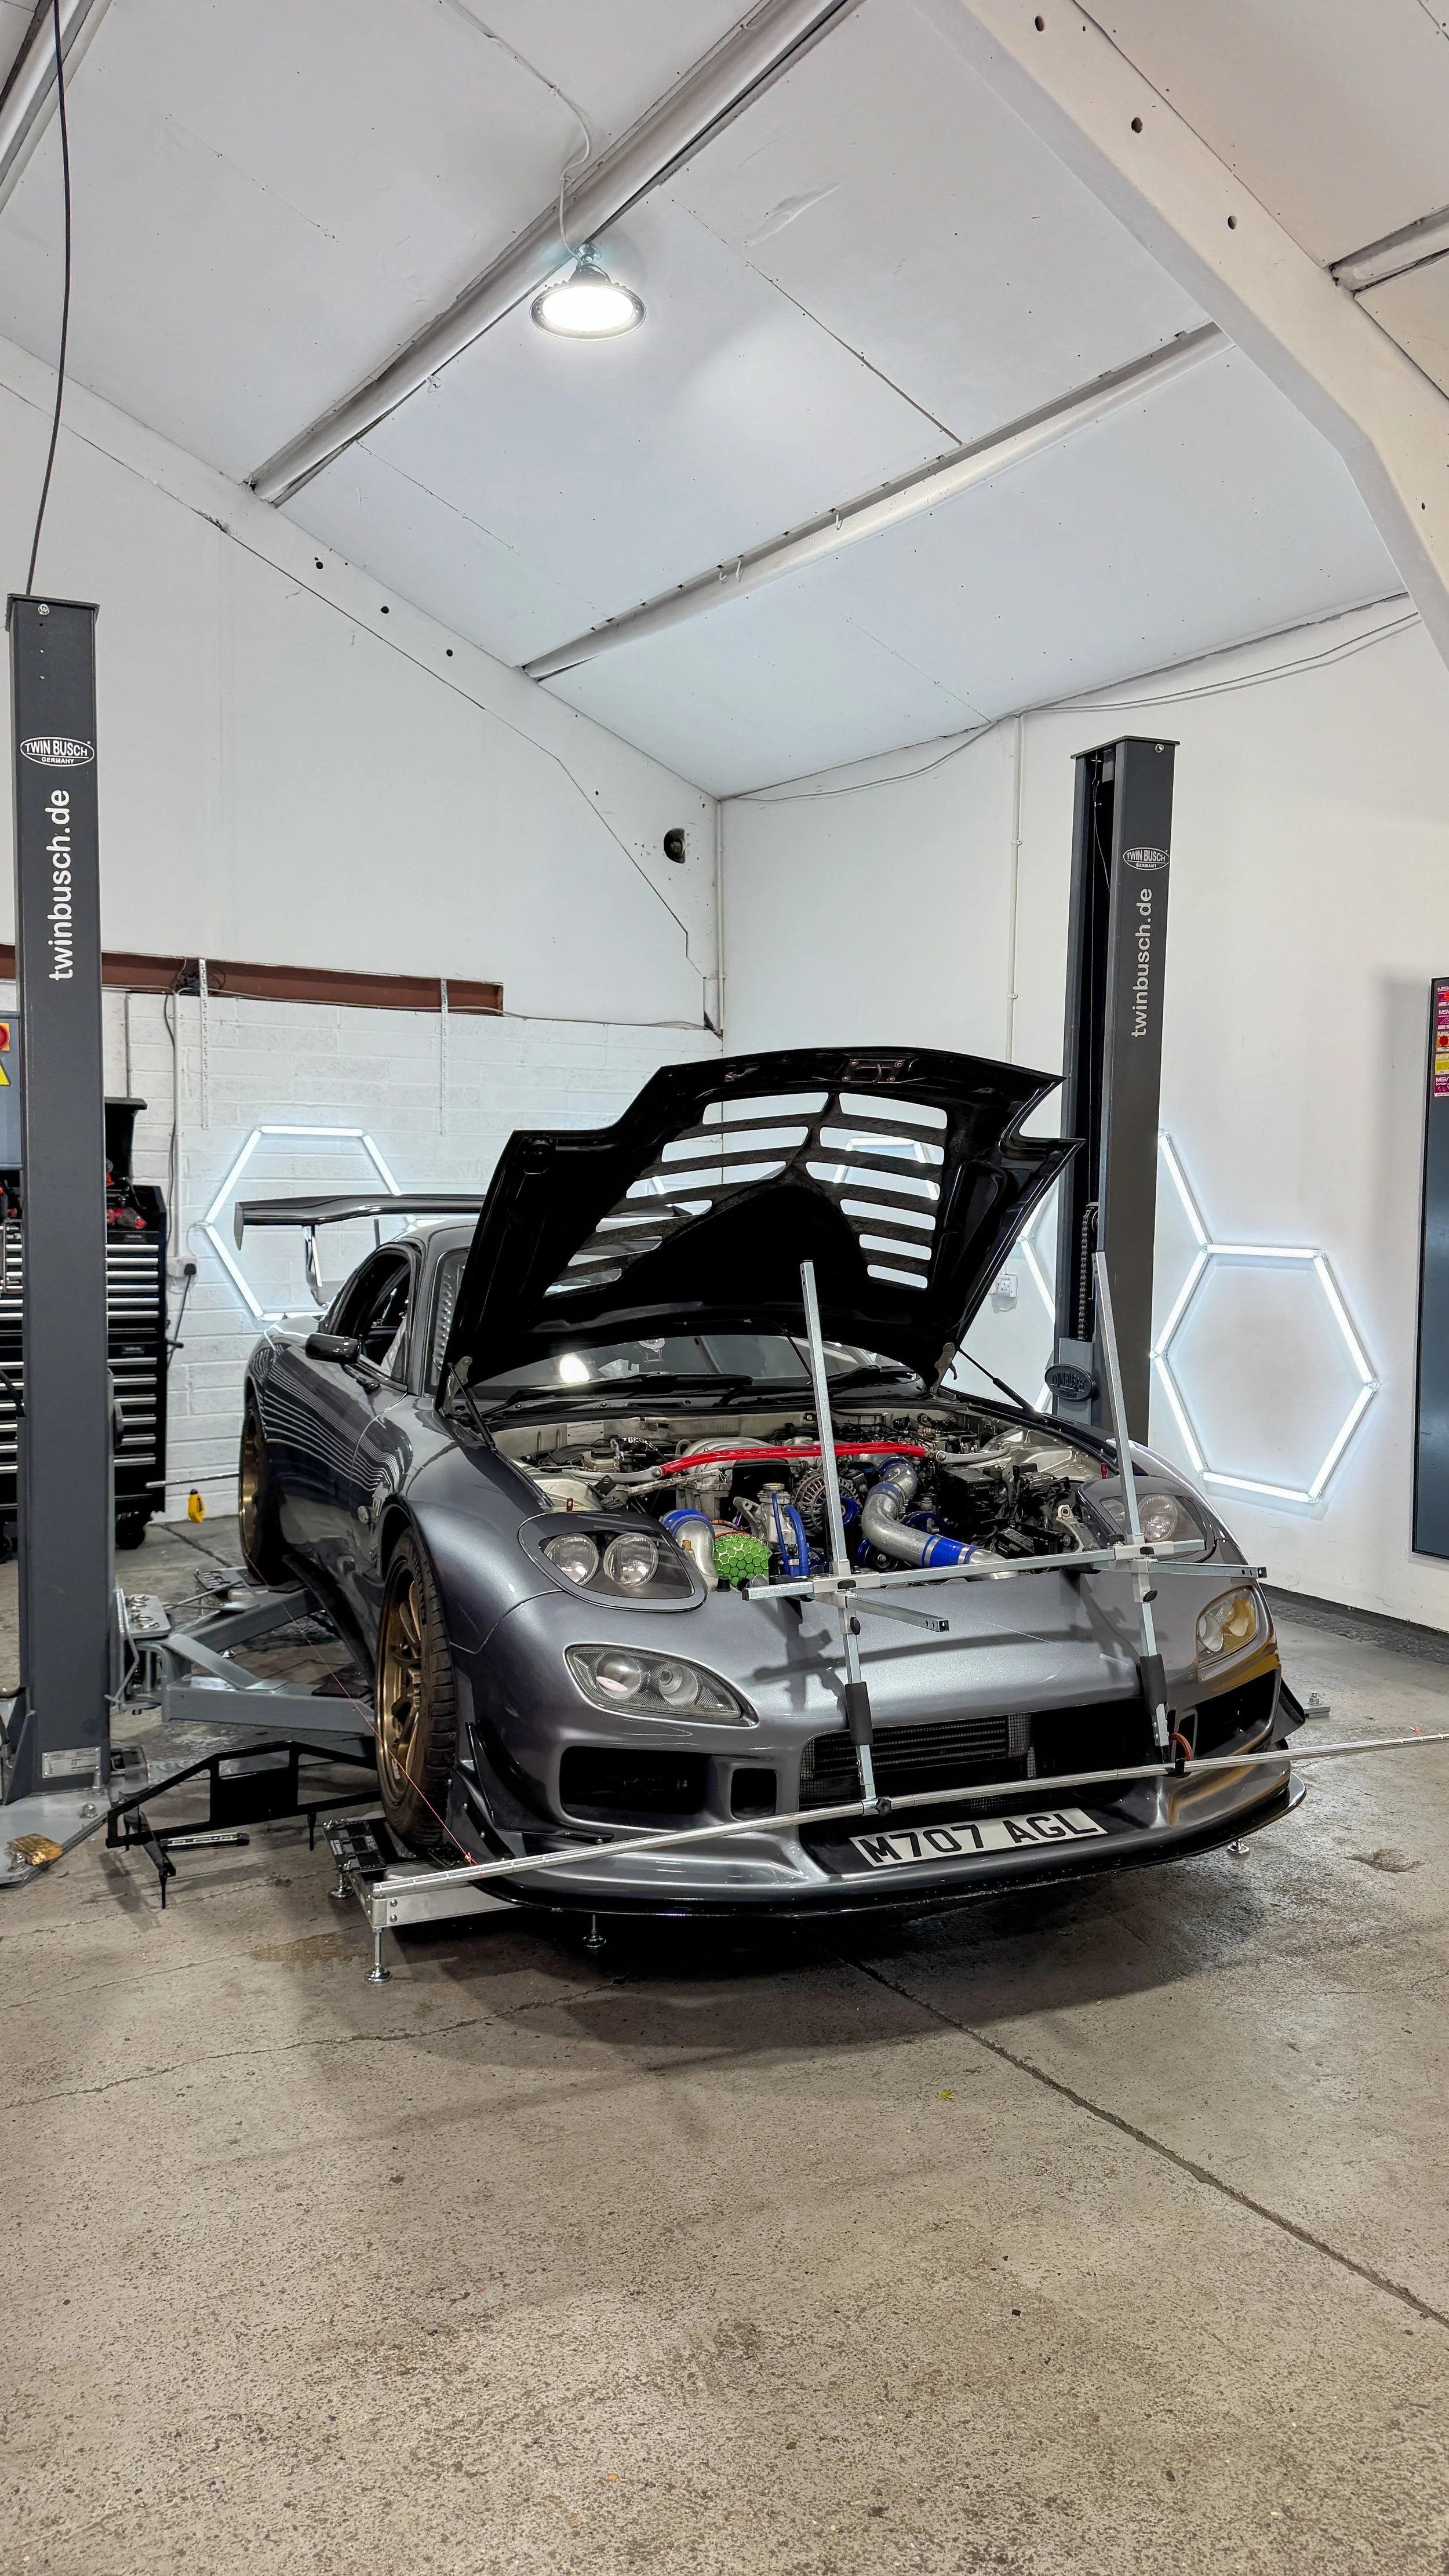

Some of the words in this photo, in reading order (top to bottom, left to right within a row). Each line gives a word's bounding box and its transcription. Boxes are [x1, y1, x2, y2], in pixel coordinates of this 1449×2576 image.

[25, 740, 50, 754] TWIN
[53, 740, 88, 756] BUSCH
[1126, 850, 1142, 861] TWIN
[1144, 850, 1166, 862] BUSCH
[45, 789, 73, 981] twinbusch.de
[1131, 888, 1152, 1037] twinbusch.de
[857, 1824, 984, 1863] M707
[1002, 1813, 1099, 1843] AGL
